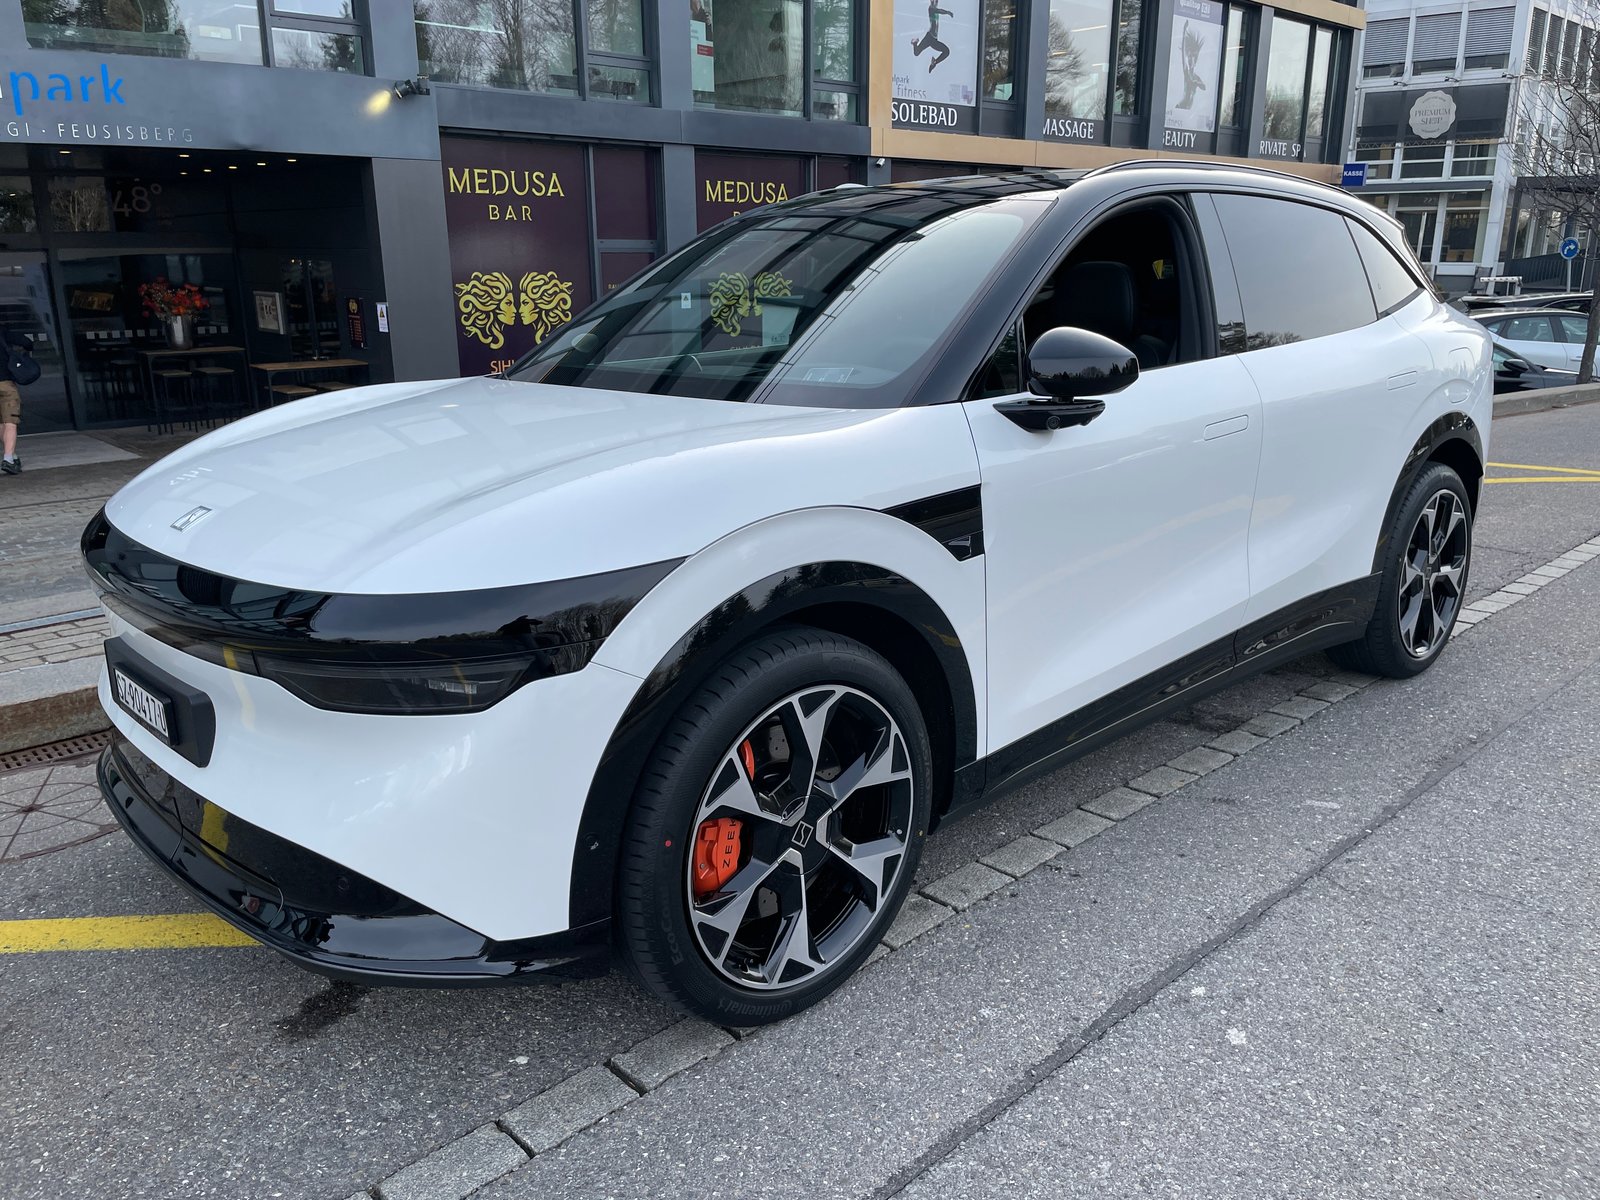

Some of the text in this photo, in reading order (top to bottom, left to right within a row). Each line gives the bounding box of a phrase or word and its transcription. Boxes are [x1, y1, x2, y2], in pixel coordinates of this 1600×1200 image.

[897, 83, 927, 99] fitness
[891, 101, 958, 127] SOLEBAD
[1415, 108, 1451, 117] PREMIUM
[57, 123, 193, 142] FEUSISBERG
[448, 167, 565, 197] MEDUSA
[705, 180, 788, 204] MEDUSA
[488, 204, 533, 222] BAR
